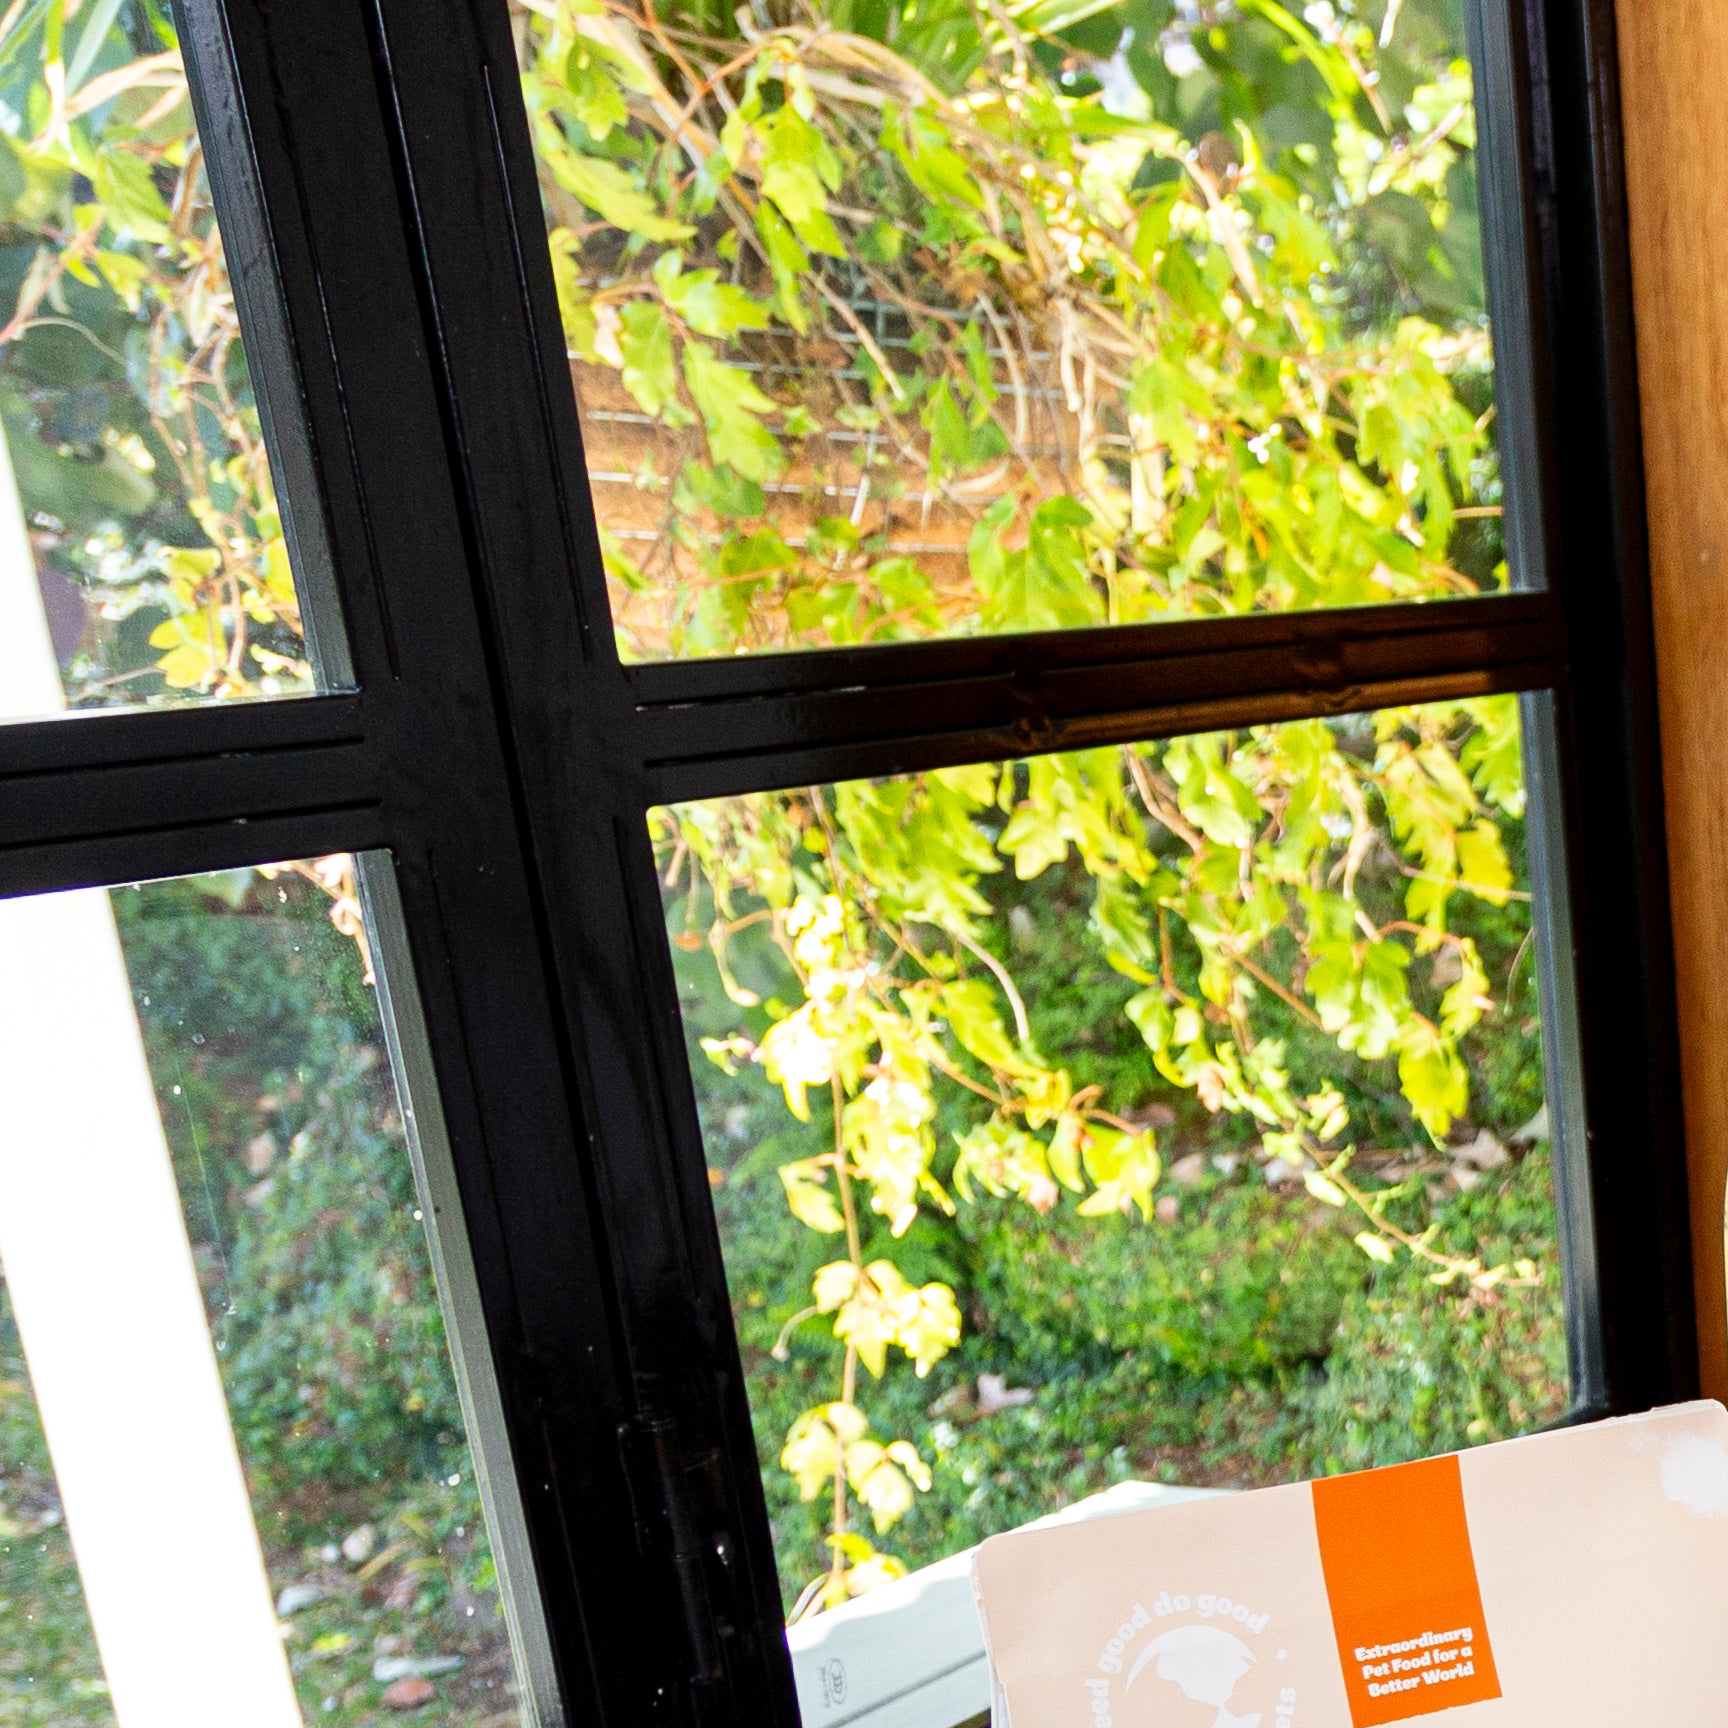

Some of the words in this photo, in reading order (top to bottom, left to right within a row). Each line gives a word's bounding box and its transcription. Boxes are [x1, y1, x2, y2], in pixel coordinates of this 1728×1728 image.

[1097, 1603, 1152, 1674] good
[1154, 1591, 1191, 1618] do
[1197, 1594, 1271, 1635] good
[1354, 1626, 1473, 1662] Extraordinary
[1361, 1664, 1391, 1680] Pet
[1391, 1651, 1432, 1674] Food
[1433, 1648, 1459, 1664] for
[1461, 1646, 1473, 1657] a
[1367, 1675, 1421, 1698] Better
[1421, 1661, 1476, 1686] World
